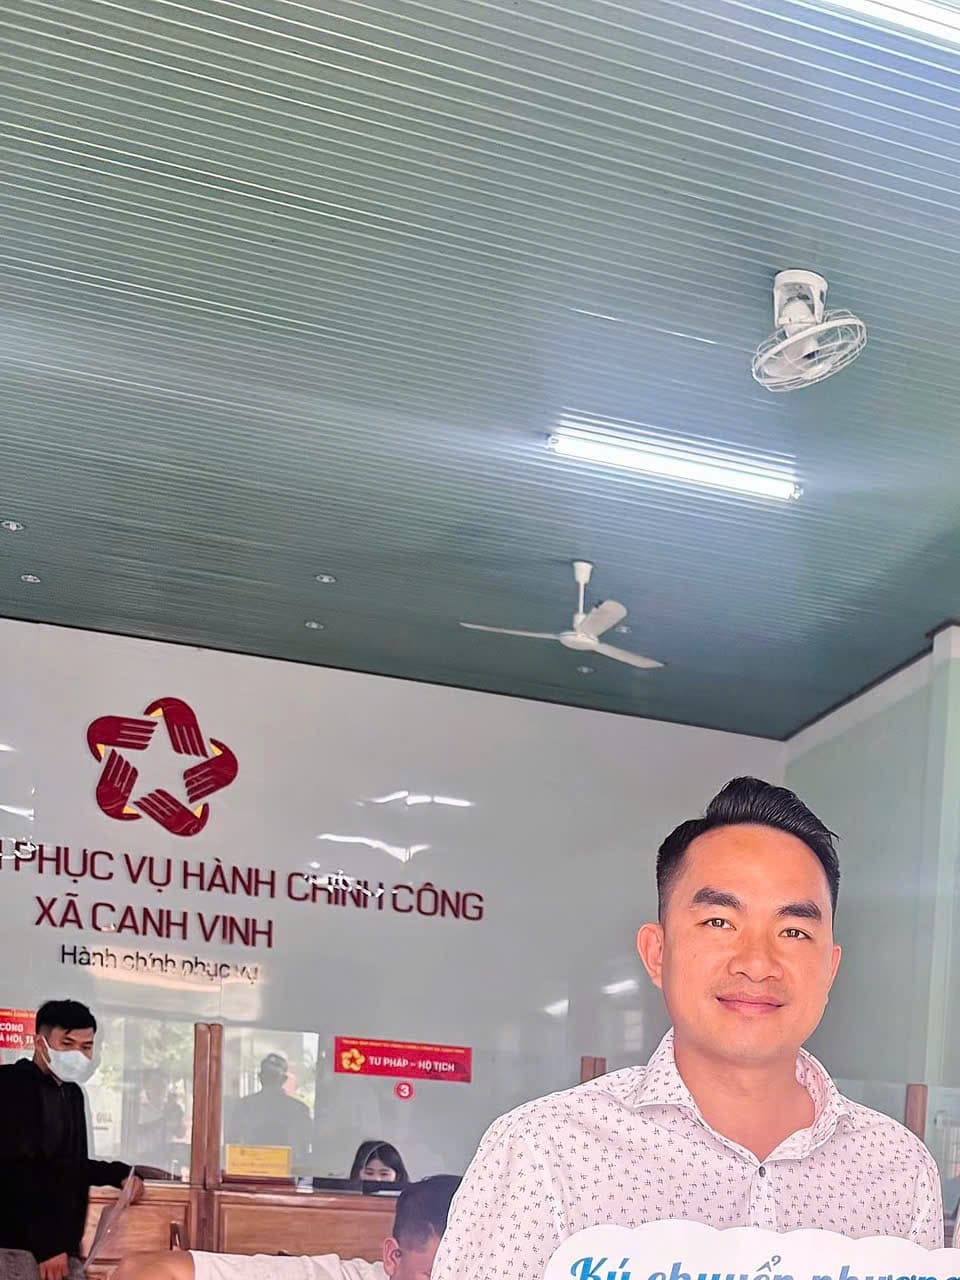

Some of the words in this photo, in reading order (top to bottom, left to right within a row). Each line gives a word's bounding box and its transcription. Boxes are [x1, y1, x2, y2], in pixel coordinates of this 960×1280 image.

[14, 840, 113, 883] PHỤC
[125, 853, 171, 893] VỤ
[183, 858, 276, 899] HÀNH
[391, 882, 484, 921] CÔNG
[35, 892, 84, 930] XÃ
[91, 902, 188, 940] CANH
[198, 912, 273, 949] VINH
[61, 945, 117, 969] Hành
[123, 952, 176, 974] chính
[182, 957, 231, 981] phục
[400, 1084, 410, 1097] 3
